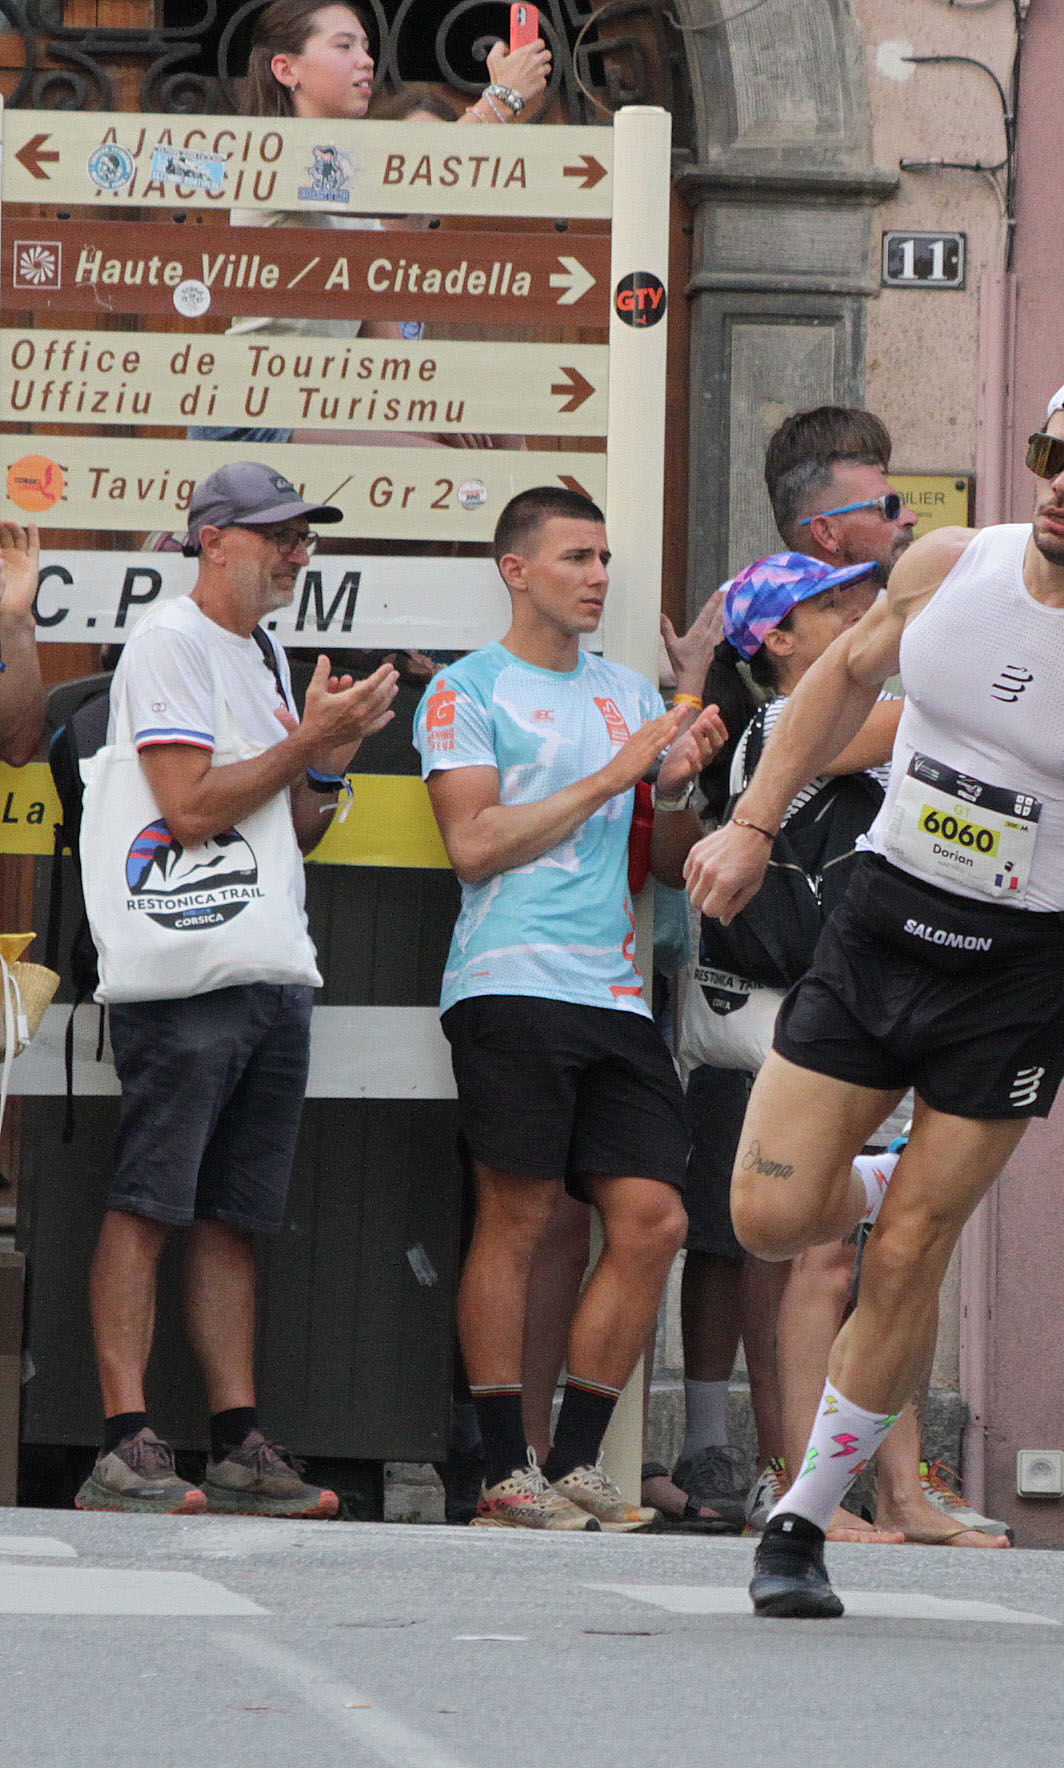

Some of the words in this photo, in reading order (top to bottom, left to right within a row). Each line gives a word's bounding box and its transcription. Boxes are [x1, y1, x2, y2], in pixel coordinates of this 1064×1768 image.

[382, 154, 527, 189] BASTIA
[74, 249, 183, 286] Haute
[202, 252, 280, 289] Ville
[324, 257, 350, 291] A
[366, 257, 533, 297] Citadella
[898, 239, 948, 280] 11
[616, 287, 664, 311] GTY
[10, 338, 141, 374] Office
[170, 343, 216, 377] de
[248, 345, 437, 382] Tourisme
[9, 379, 152, 414] Uffiziu
[180, 384, 218, 417] di
[243, 386, 270, 418] U
[299, 387, 465, 423] Turismu
[369, 476, 415, 509] Gr
[430, 478, 455, 510] 2
[2, 791, 46, 825] La
[923, 811, 995, 853] 6060
[932, 843, 974, 868] Dorian
[127, 894, 217, 911] RESTONICA
[219, 887, 266, 901] TRAIL
[174, 913, 224, 929] CORSICA
[903, 918, 993, 952] SALOMON
